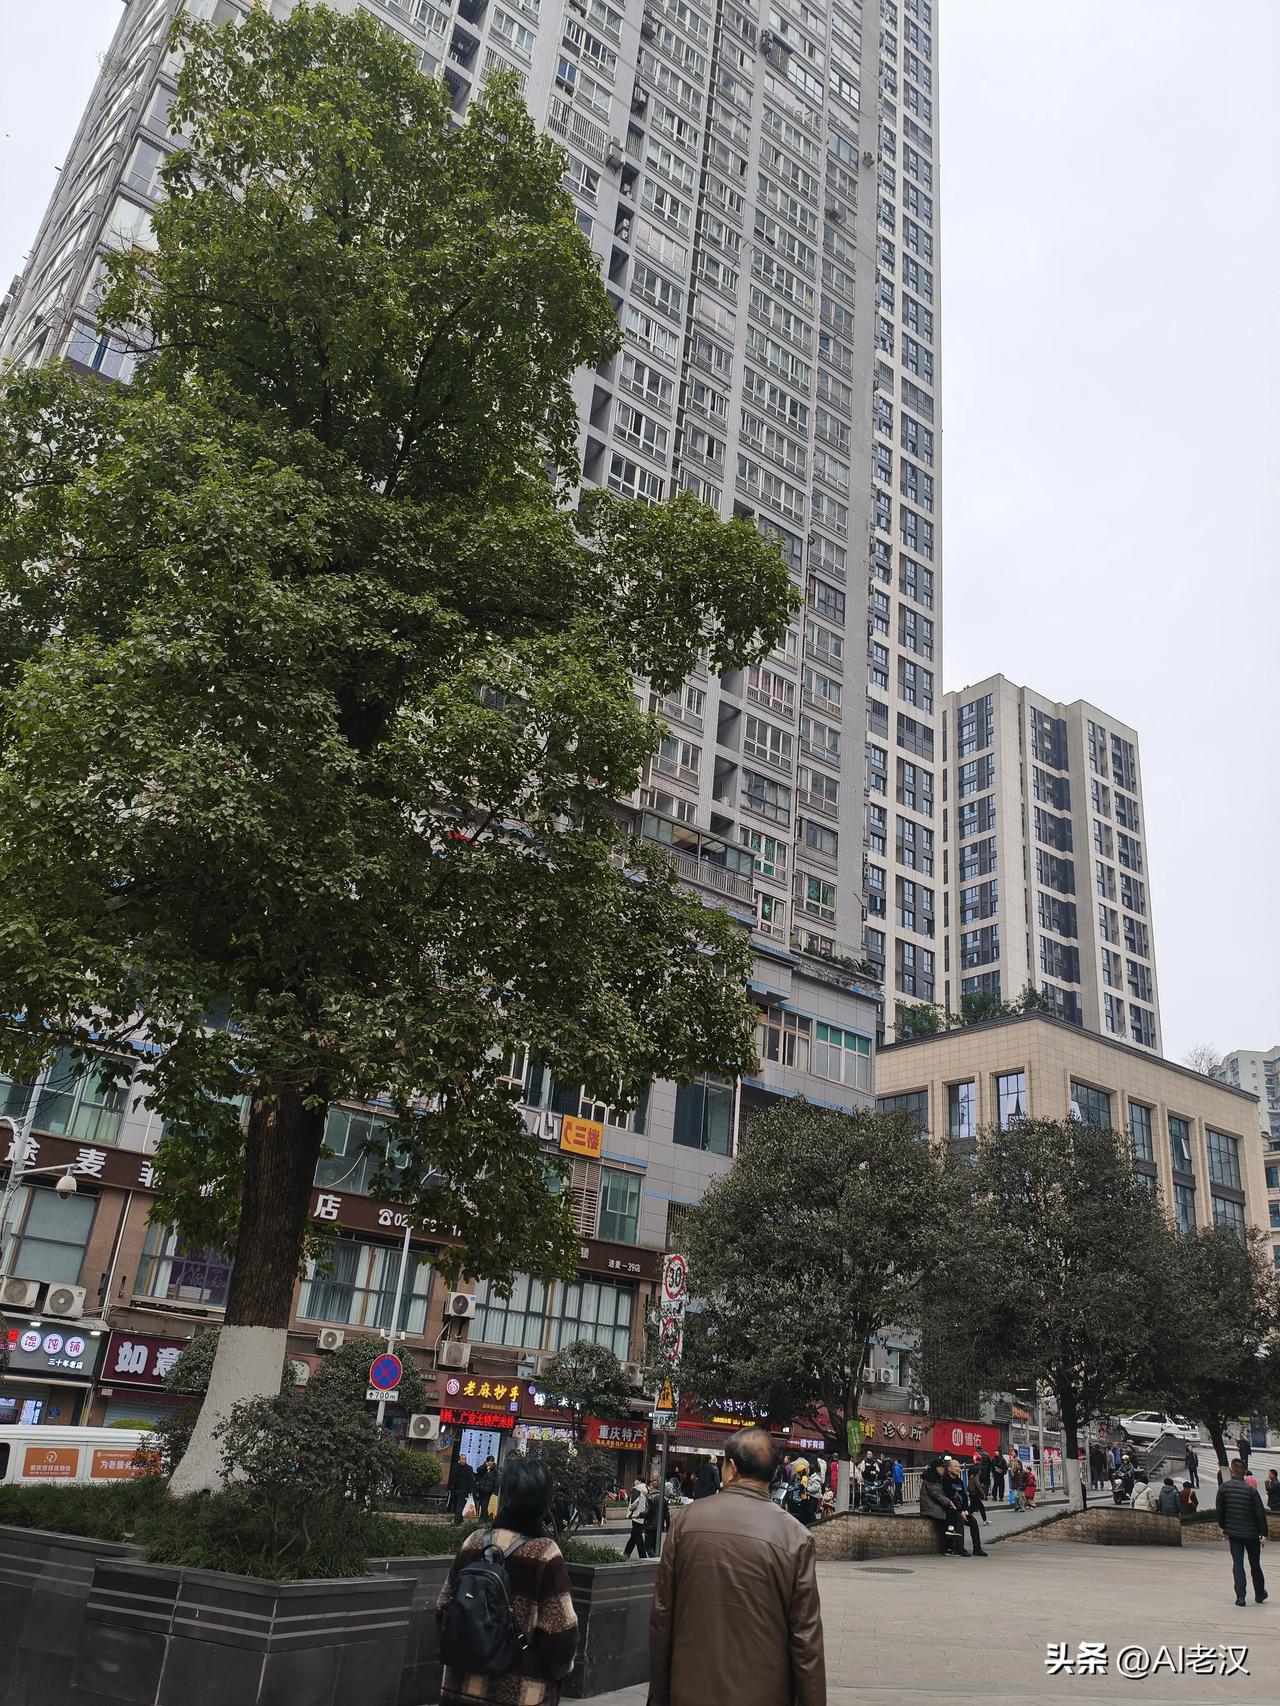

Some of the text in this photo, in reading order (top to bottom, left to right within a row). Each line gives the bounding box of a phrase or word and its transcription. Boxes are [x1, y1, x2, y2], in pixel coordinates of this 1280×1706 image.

[573, 1125, 600, 1150] 三楼
[313, 1194, 342, 1221] 店
[668, 1267, 682, 1289] 30
[375, 1392, 396, 1400] 700m
[462, 1380, 521, 1403] 老麻抄手
[598, 1424, 644, 1442] 重庆特产
